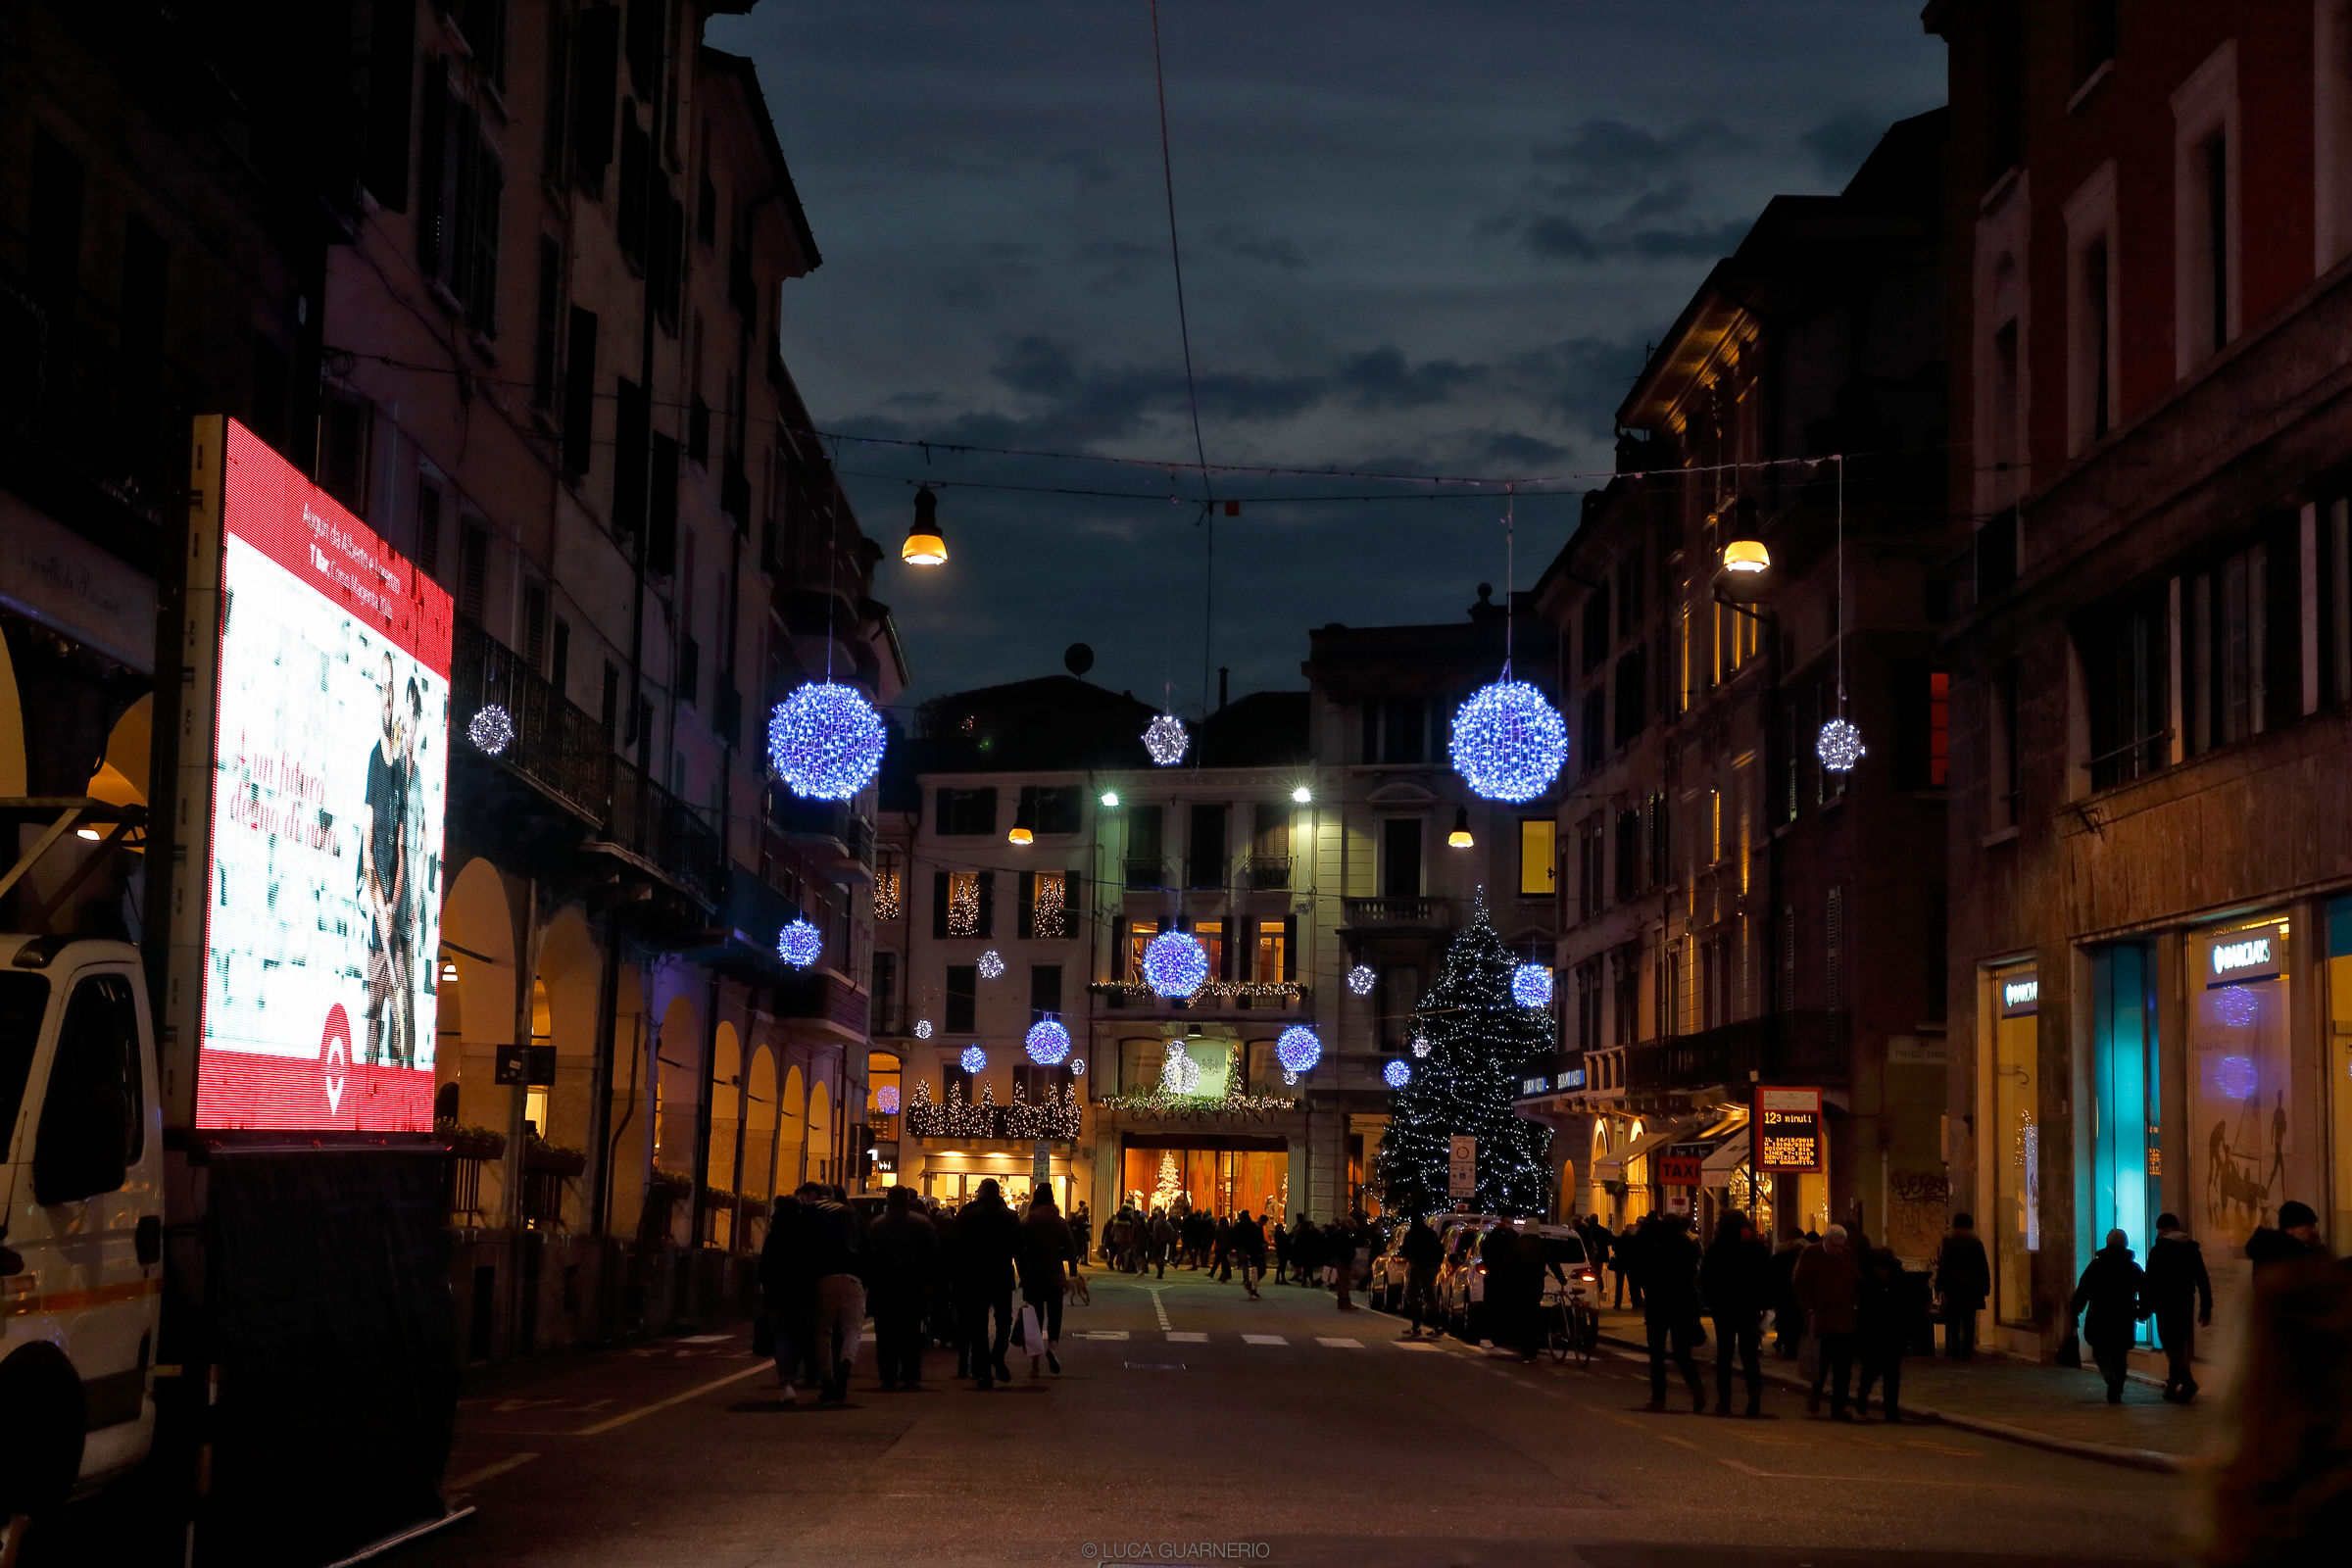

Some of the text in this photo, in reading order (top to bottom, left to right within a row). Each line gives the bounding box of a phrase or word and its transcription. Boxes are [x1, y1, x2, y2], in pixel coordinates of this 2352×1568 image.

[2224, 938, 2271, 969] BARCLAYS
[1131, 1110, 1275, 1124] CAPRETTINI
[1662, 1164, 1699, 1178] TAXI
